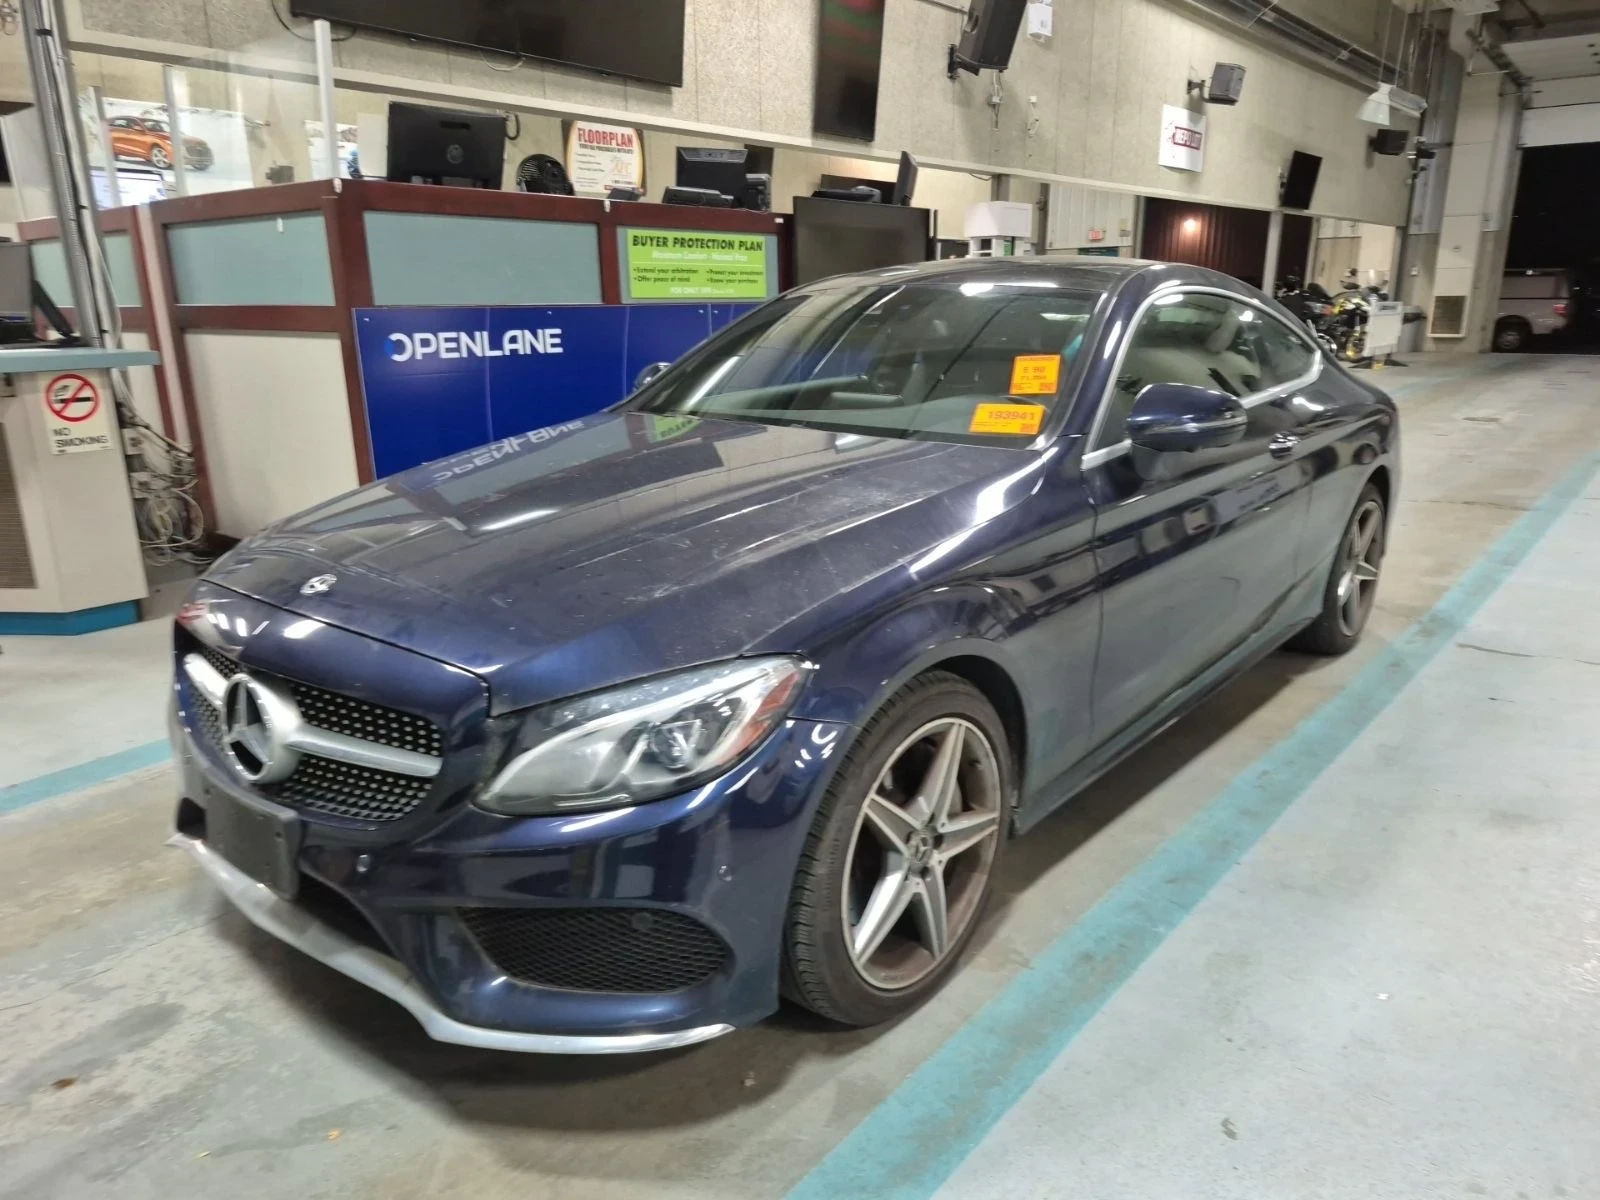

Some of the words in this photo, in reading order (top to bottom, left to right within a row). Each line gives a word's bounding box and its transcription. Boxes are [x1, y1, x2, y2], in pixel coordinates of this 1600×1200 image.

[578, 128, 633, 147] FLOORPLAN
[632, 235, 669, 248] BUYER
[673, 237, 735, 250] PROTECTION
[739, 240, 763, 252] PLAN
[384, 328, 564, 362] OPENLANE
[53, 427, 71, 436] NO
[56, 435, 109, 448] SMOKING
